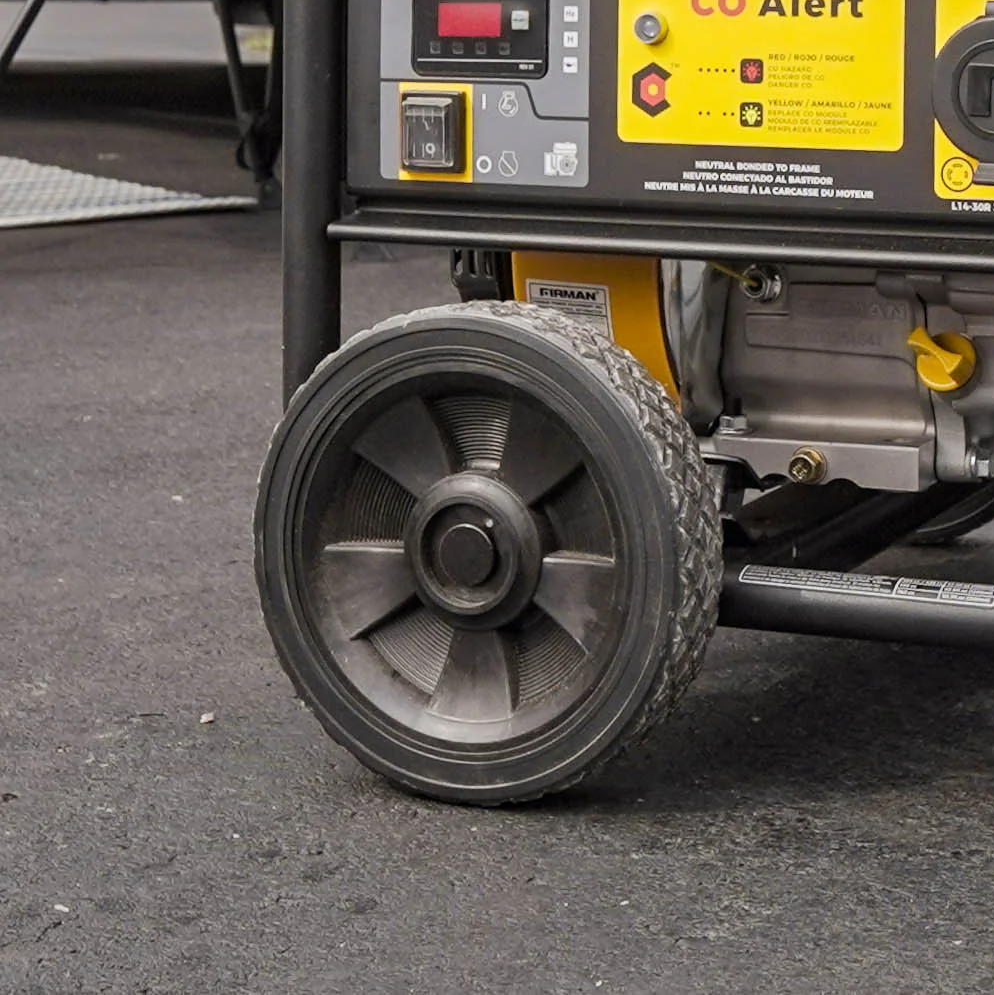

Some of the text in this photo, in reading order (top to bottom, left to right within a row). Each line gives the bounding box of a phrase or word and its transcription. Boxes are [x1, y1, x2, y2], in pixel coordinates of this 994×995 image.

[768, 53, 786, 61] RED
[768, 99, 803, 107] YELLOW
[863, 102, 893, 110] JAUNE
[694, 160, 821, 174] NEUTRAL BONDED TO FRAME
[682, 171, 834, 185] NEUTRO CONECTADO AL BASTIDOR
[644, 181, 679, 191] NEUTRE
[680, 183, 696, 192] MIS
[705, 184, 717, 193] LA
[719, 184, 749, 194] MASSE
[759, 186, 771, 195] LA
[772, 186, 819, 197] CARCASSE
[820, 188, 834, 197] DU
[835, 189, 874, 199] MOTEUR
[951, 201, 991, 212] L14-30R
[540, 288, 596, 301] FIRMAN
